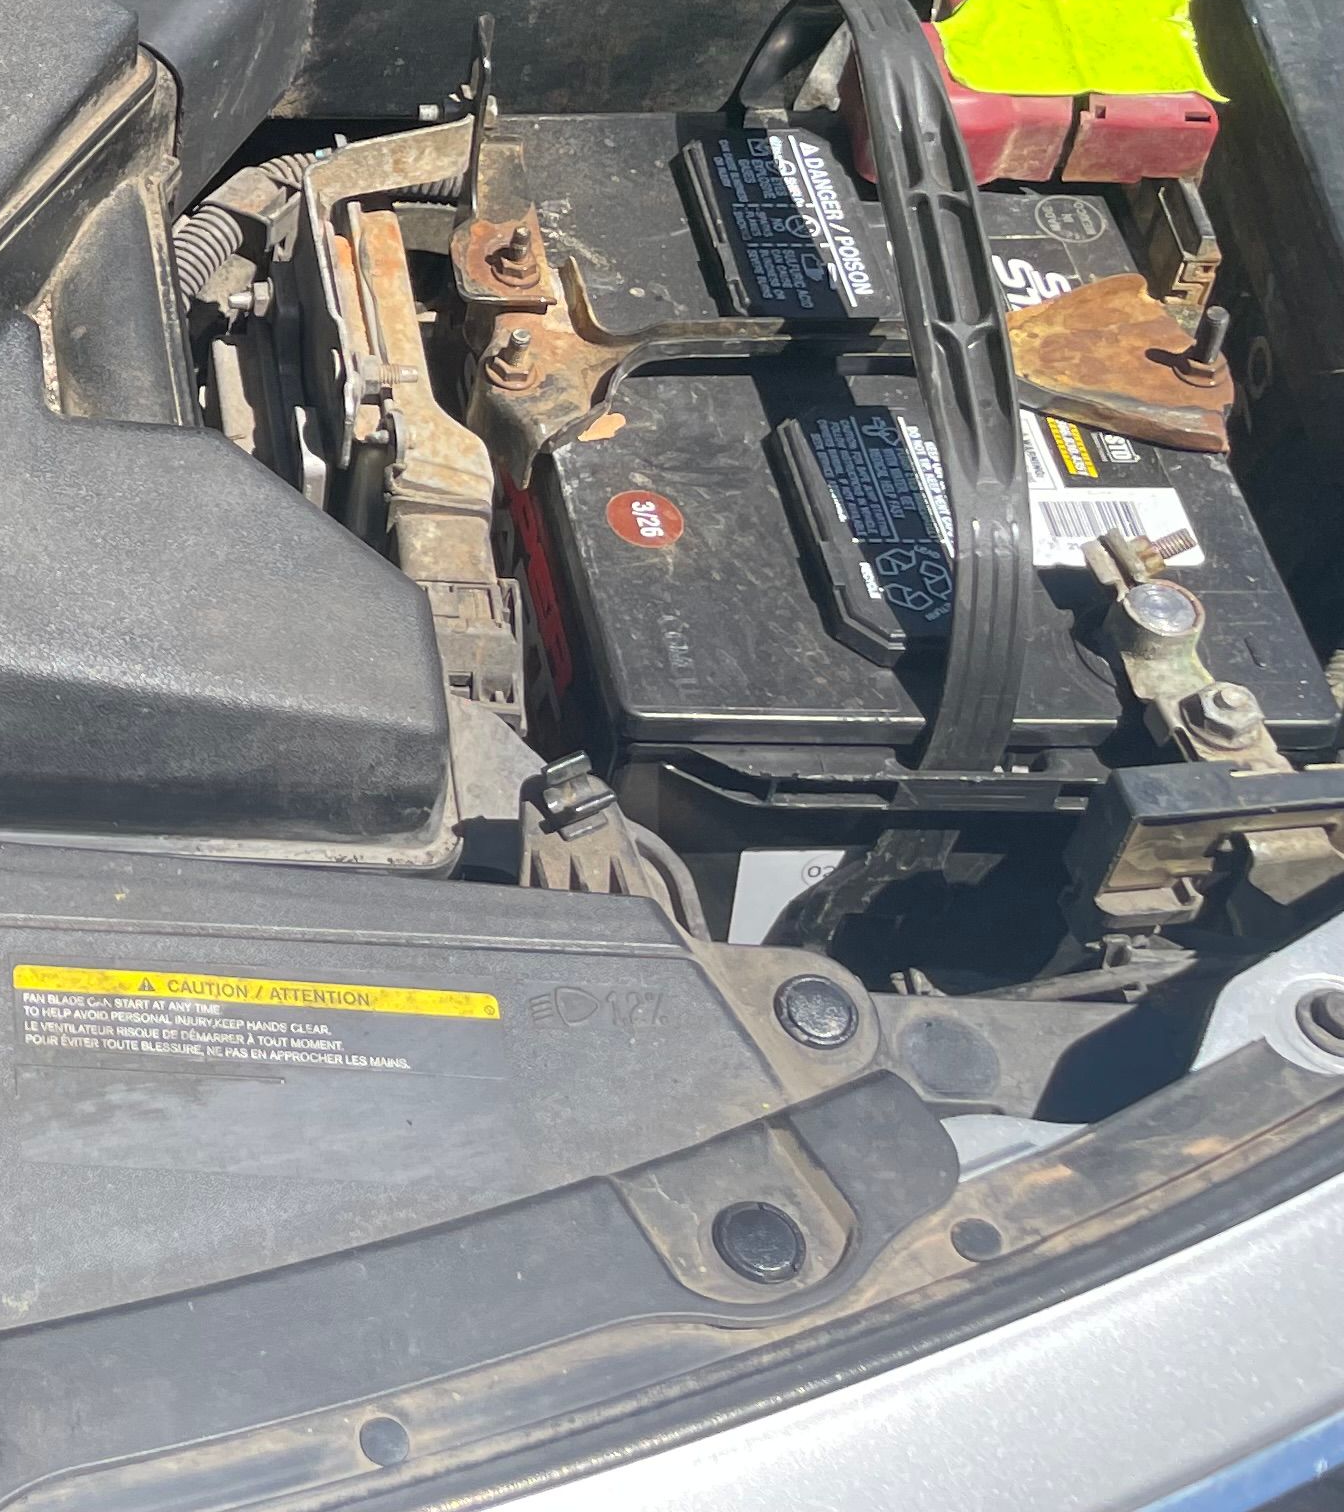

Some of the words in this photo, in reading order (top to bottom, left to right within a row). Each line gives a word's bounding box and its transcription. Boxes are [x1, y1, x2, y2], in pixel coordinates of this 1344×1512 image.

[772, 218, 785, 232] NO
[804, 158, 844, 220] DANGER
[834, 236, 873, 295] POISON
[1042, 207, 1061, 231] MADE
[1074, 200, 1096, 235] MEXICO
[906, 426, 921, 438] DO
[912, 440, 927, 455] NOT
[880, 480, 897, 498] HELP
[631, 501, 664, 538] 3/26
[23, 992, 45, 1004] FAN
[48, 994, 84, 1006] BLADE
[114, 998, 149, 1010] START
[152, 1000, 165, 1010] AT
[169, 1001, 192, 1012] ANY
[168, 979, 247, 998] CAUTION
[270, 987, 371, 1006] ATTENTION
[24, 1006, 39, 1016] TO
[42, 1007, 71, 1018] HELP
[73, 1009, 108, 1020] AVOID
[111, 1011, 172, 1024] PERSONAL
[247, 1021, 288, 1033] HANDS
[290, 1023, 331, 1036] CLEAR.
[25, 1021, 38, 1031] LE
[40, 1022, 113, 1036] VENTILATEUR
[116, 1027, 159, 1039] RISQUE
[162, 1029, 177, 1039] DE
[181, 1028, 245, 1044] DÉMARRER
[258, 1036, 289, 1048] TOUT
[25, 1034, 58, 1046] POUR
[61, 1034, 100, 1048] ÉVITER
[102, 1038, 139, 1051] TOUTE
[141, 1041, 205, 1056] BLESSURE,
[207, 1046, 223, 1057] NE
[225, 1048, 249, 1059] PAS
[251, 1049, 267, 1059] EN
[269, 1051, 343, 1065] APPROCHER
[345, 1055, 368, 1066] LES
[369, 1057, 411, 1069] MAINS.
